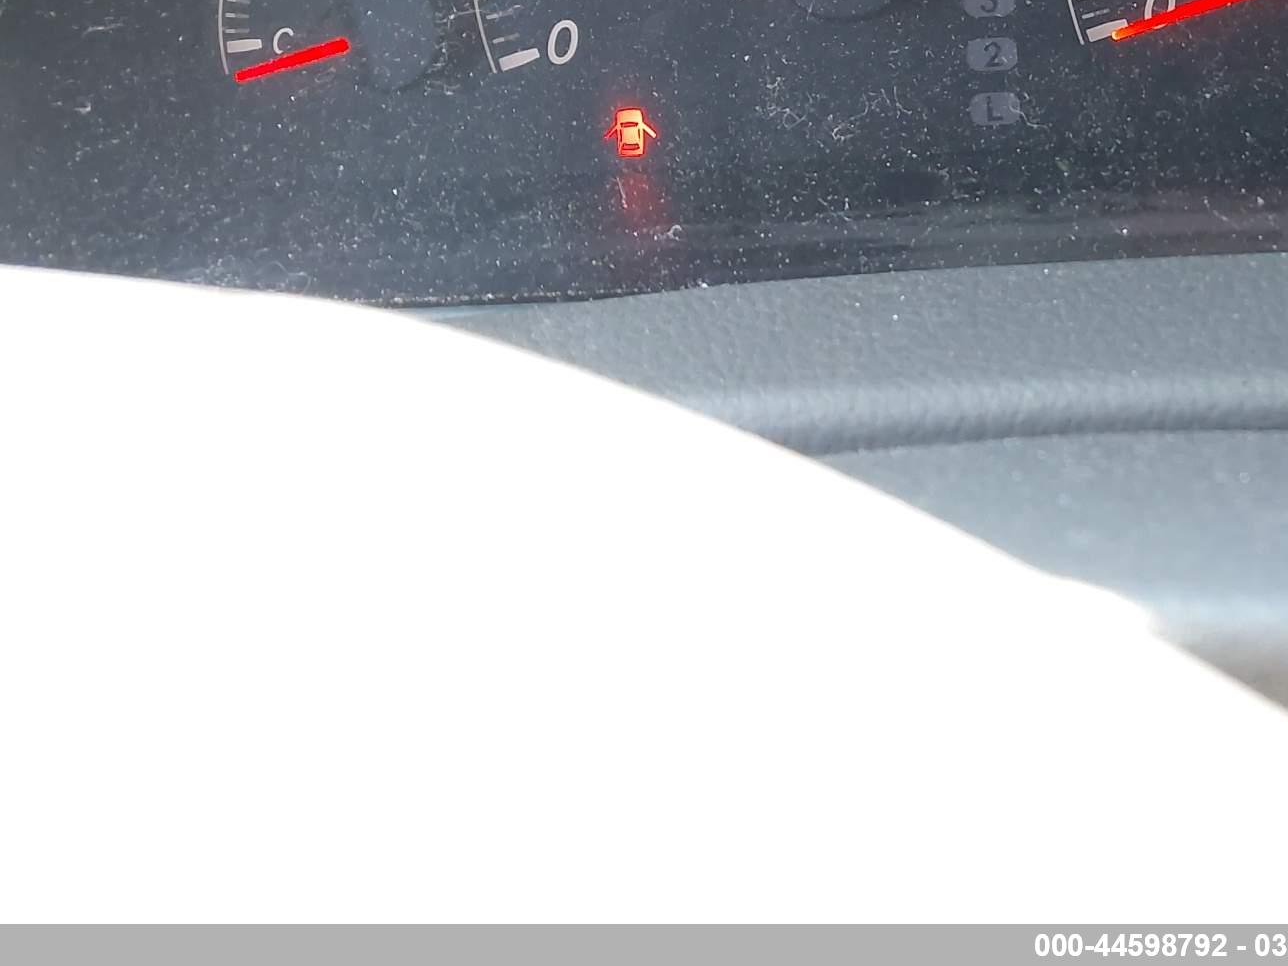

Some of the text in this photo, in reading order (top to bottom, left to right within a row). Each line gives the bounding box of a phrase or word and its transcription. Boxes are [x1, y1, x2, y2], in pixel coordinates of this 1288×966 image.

[273, 28, 295, 54] C
[547, 19, 579, 65] 0
[983, 43, 1003, 68] 2
[986, 100, 1003, 121] L
